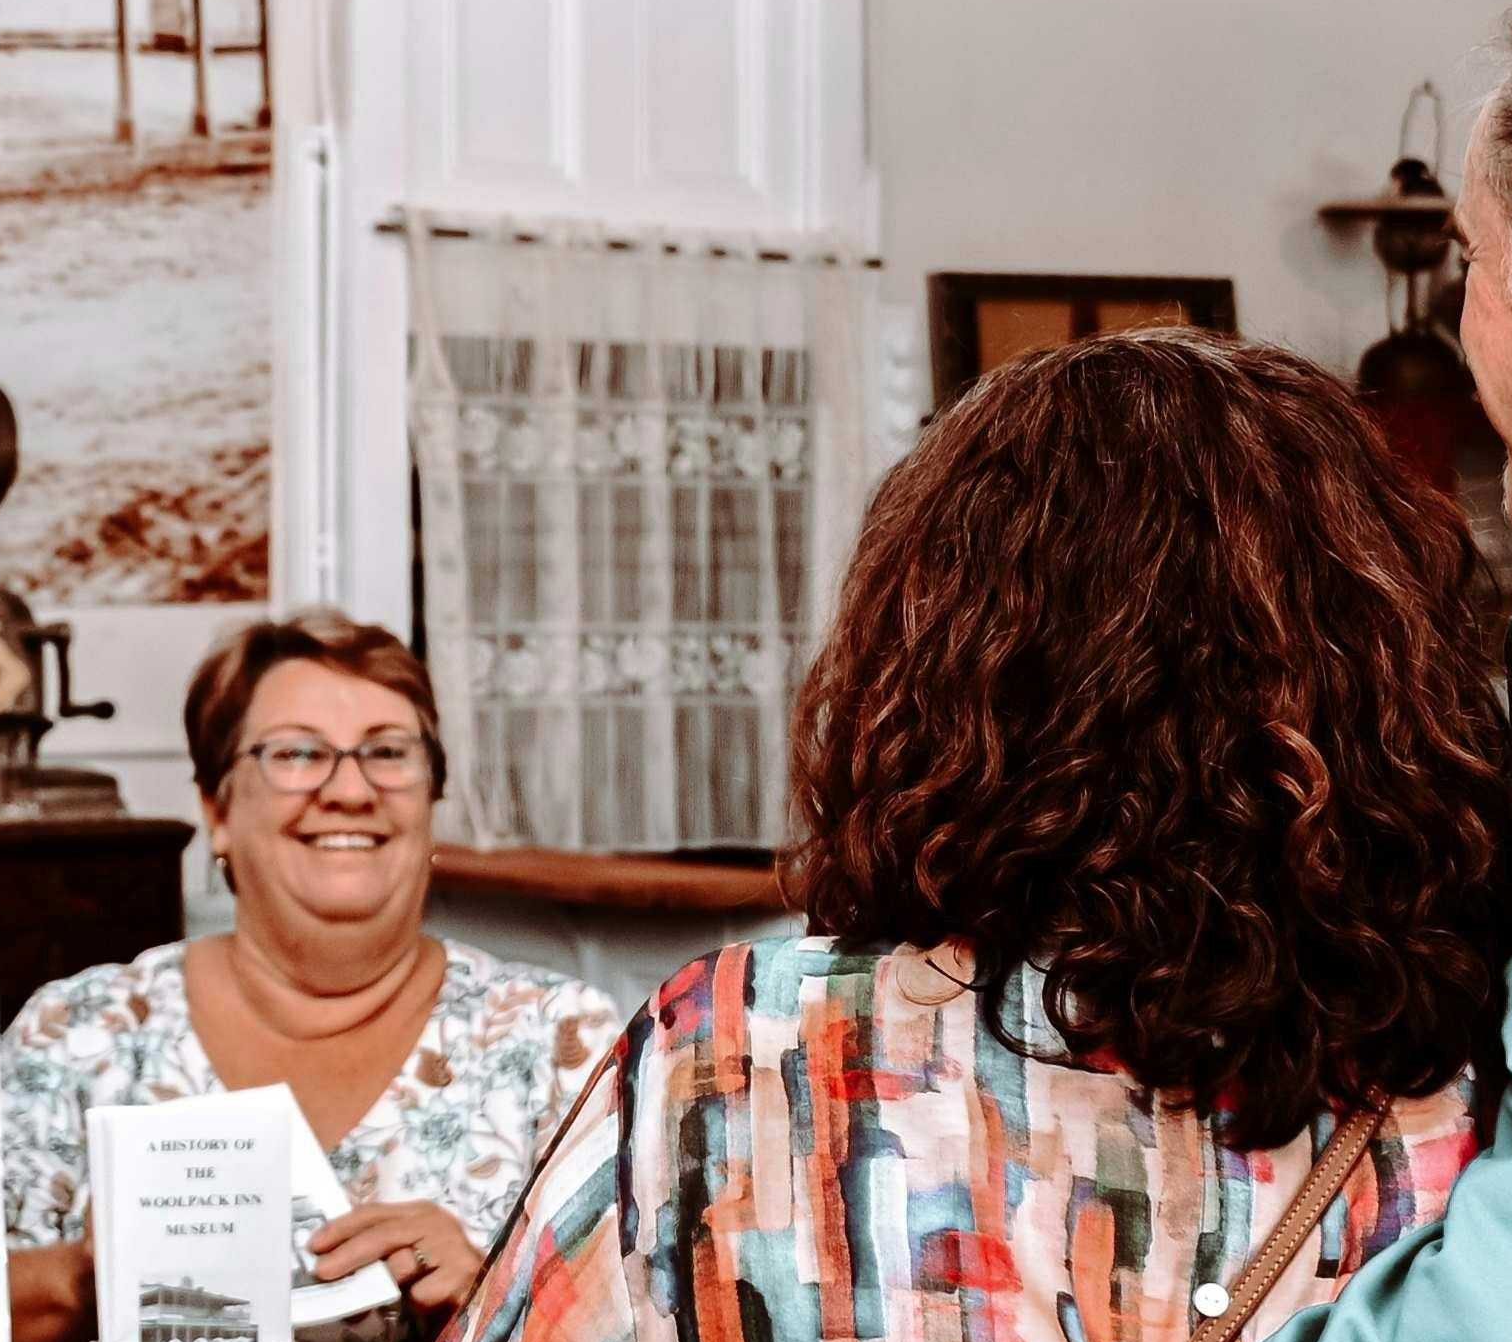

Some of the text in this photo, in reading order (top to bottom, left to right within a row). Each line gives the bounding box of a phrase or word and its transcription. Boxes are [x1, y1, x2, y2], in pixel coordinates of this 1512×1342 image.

[146, 1138, 257, 1153] A HISTORY OF
[184, 1166, 217, 1180] THE
[139, 1193, 263, 1210] WOOLPACK INN
[165, 1222, 235, 1237] MUSEUM
